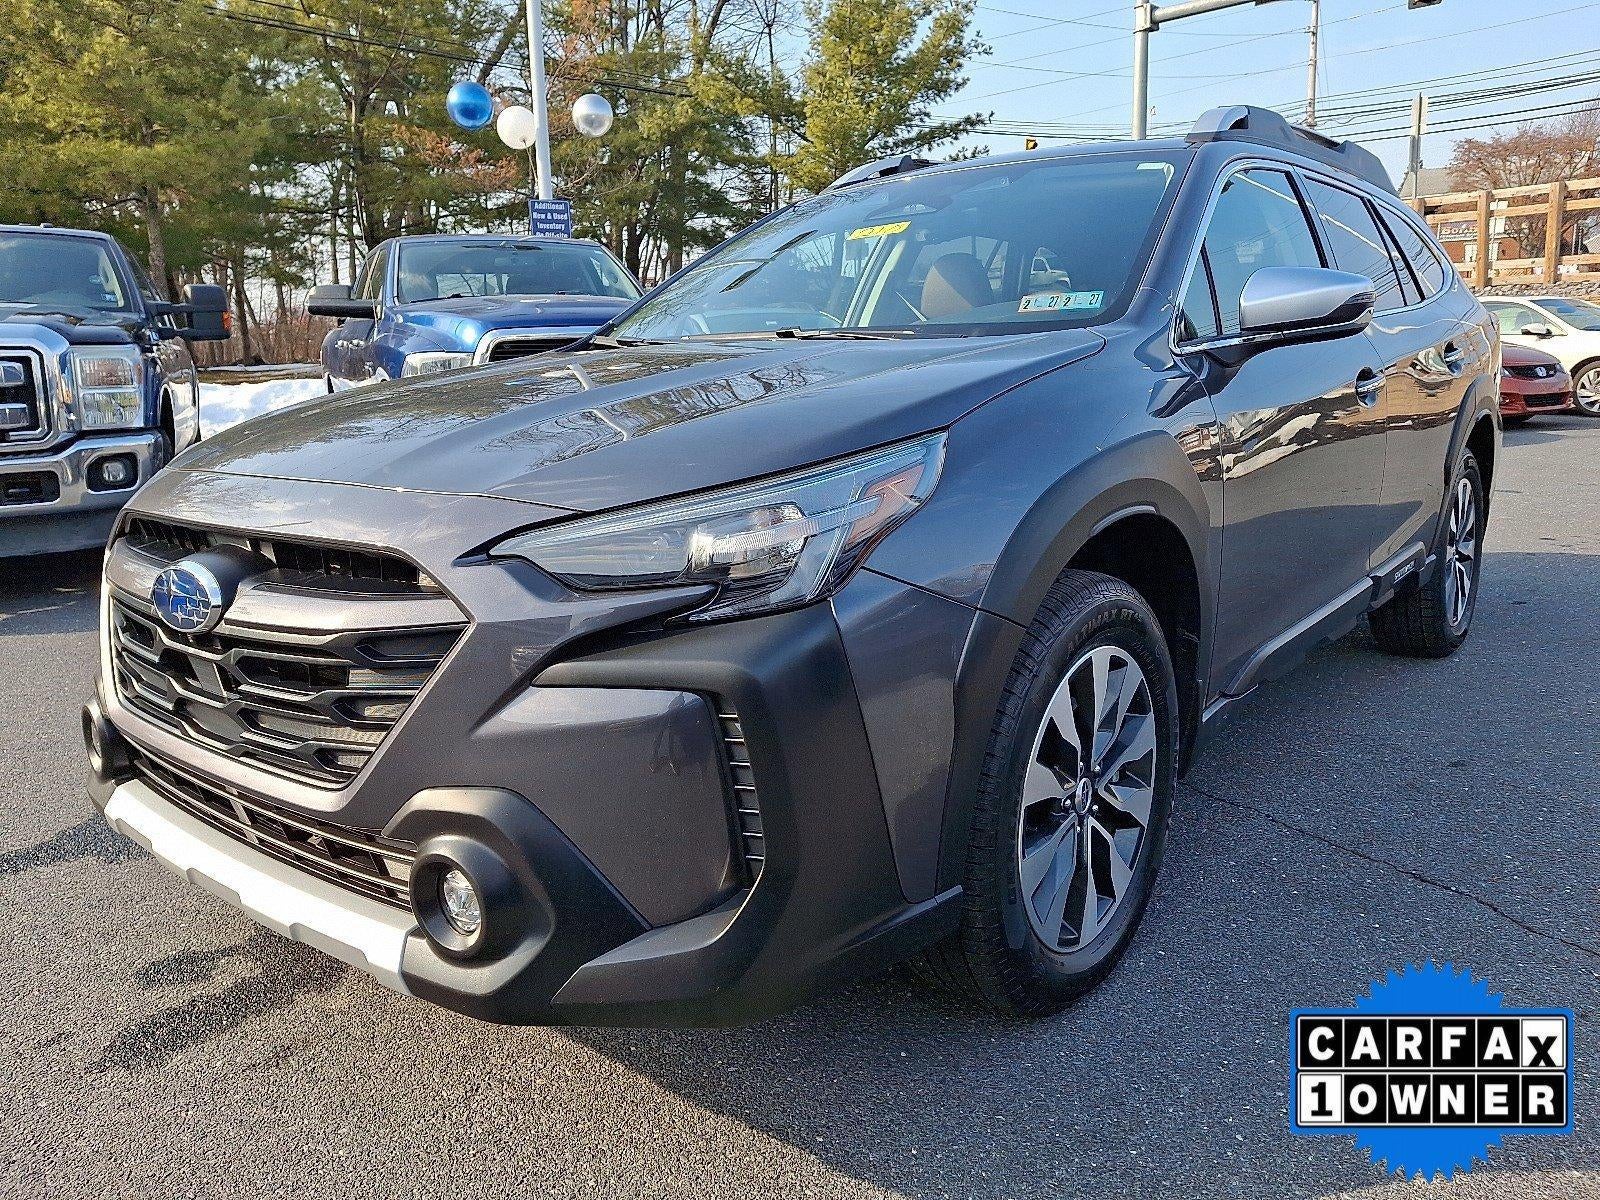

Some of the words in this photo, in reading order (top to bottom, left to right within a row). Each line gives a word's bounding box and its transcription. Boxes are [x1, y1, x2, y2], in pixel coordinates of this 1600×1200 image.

[534, 202, 565, 210] Additional
[546, 212, 552, 220] &
[537, 222, 565, 230] Inventory
[1022, 299, 1031, 310] 2
[1048, 295, 1060, 308] 27
[1063, 296, 1071, 307] 2
[1088, 293, 1100, 305] 27
